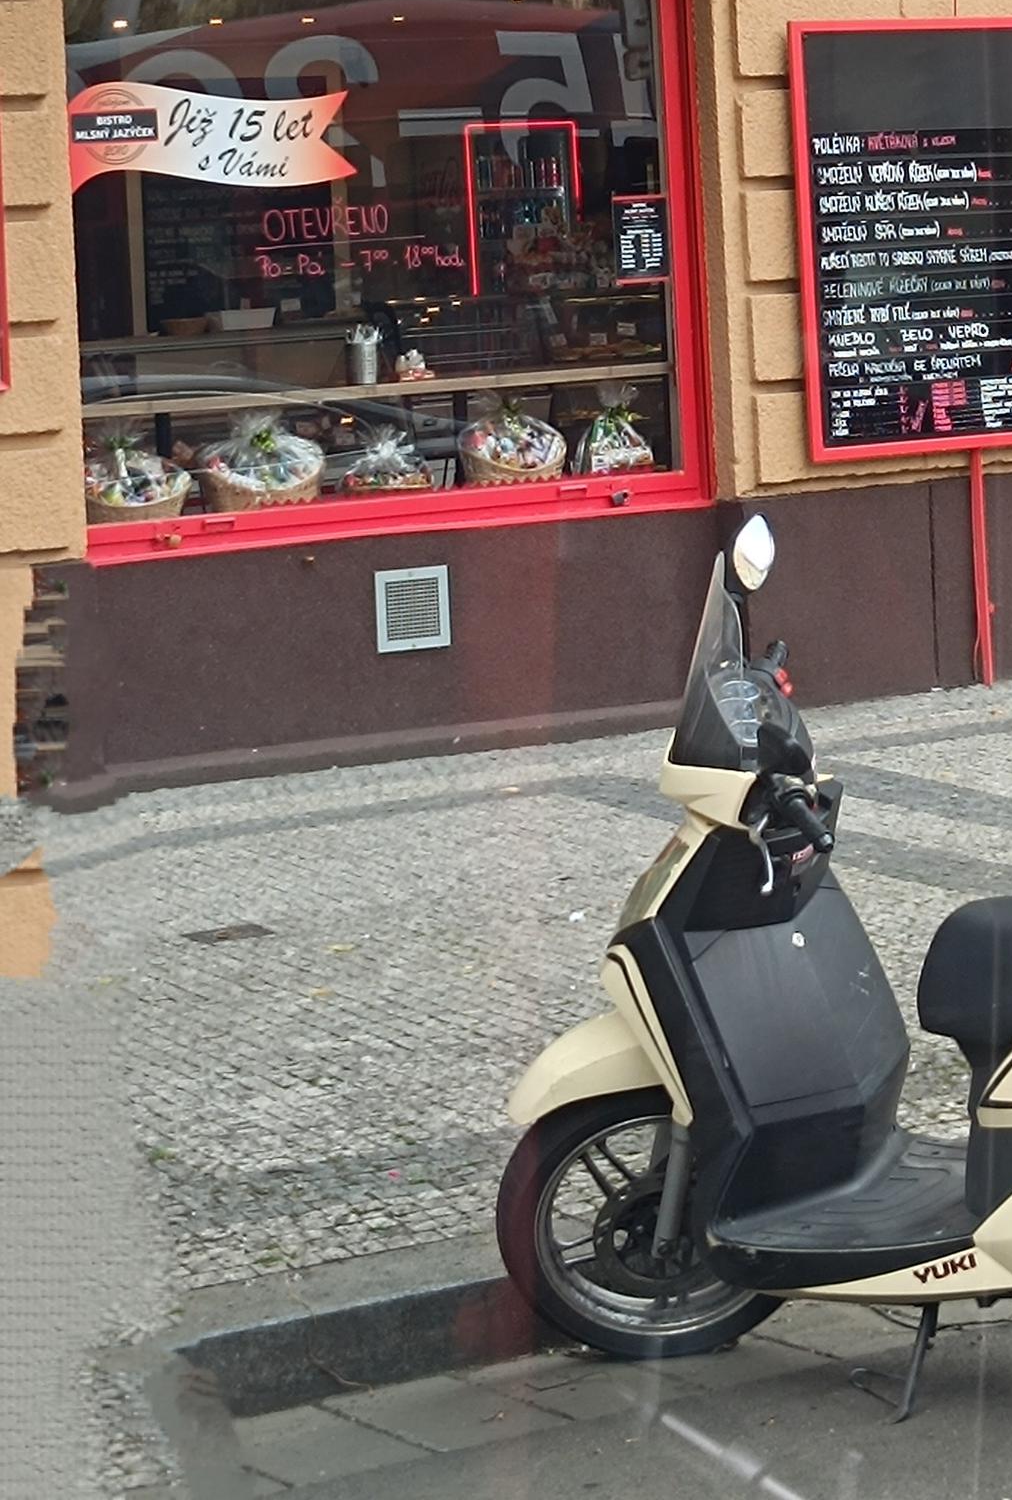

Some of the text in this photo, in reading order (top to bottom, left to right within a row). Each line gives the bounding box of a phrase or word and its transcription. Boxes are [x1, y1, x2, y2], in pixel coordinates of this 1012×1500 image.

[96, 115, 132, 125] BISTRO
[164, 97, 316, 148] Již 15 let
[217, 148, 290, 178] Vámi
[828, 331, 876, 348] KNEDLO
[912, 1252, 978, 1285] YUKI
